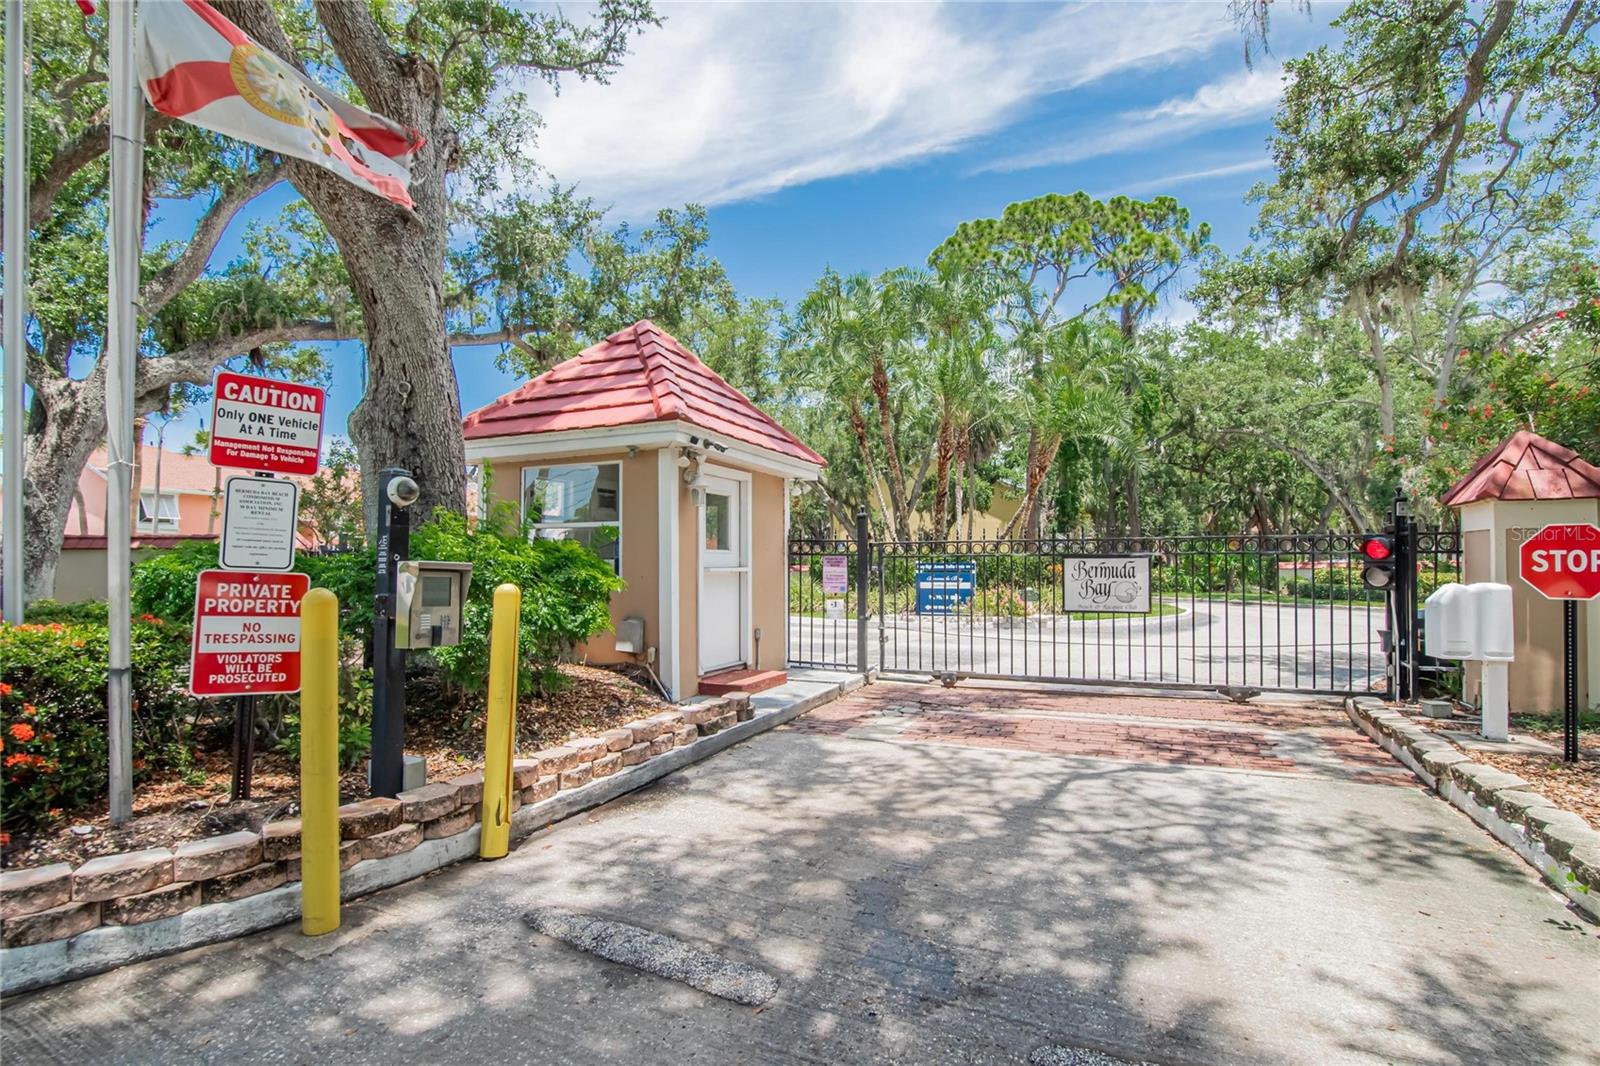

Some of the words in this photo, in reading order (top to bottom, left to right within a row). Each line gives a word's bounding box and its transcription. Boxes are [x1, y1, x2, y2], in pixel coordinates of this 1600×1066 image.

[224, 382, 317, 411] CAUTION
[217, 407, 244, 423] Only
[248, 412, 274, 424] ONE
[278, 416, 318, 431] Vehicle
[239, 423, 252, 434] At
[256, 426, 265, 436] A
[270, 427, 297, 440] Time
[214, 439, 260, 451] Management
[261, 444, 275, 453] Not
[276, 446, 316, 458] Responsible
[226, 449, 238, 457] For
[240, 450, 269, 460] Damage
[270, 453, 278, 461] To
[280, 455, 304, 464] Vehicle
[1531, 549, 1600, 573] STOP
[1071, 560, 1136, 581] Bermuda
[216, 582, 292, 599] PRIVATE
[1078, 579, 1117, 604] Bay
[204, 598, 300, 614] PROPERTY
[242, 622, 262, 633] NO
[204, 633, 296, 645] TRESPASSING
[216, 654, 282, 664] VIOLATORS
[225, 664, 254, 674] WILL
[257, 664, 273, 673] BE
[208, 673, 287, 685] PROSECUTED
